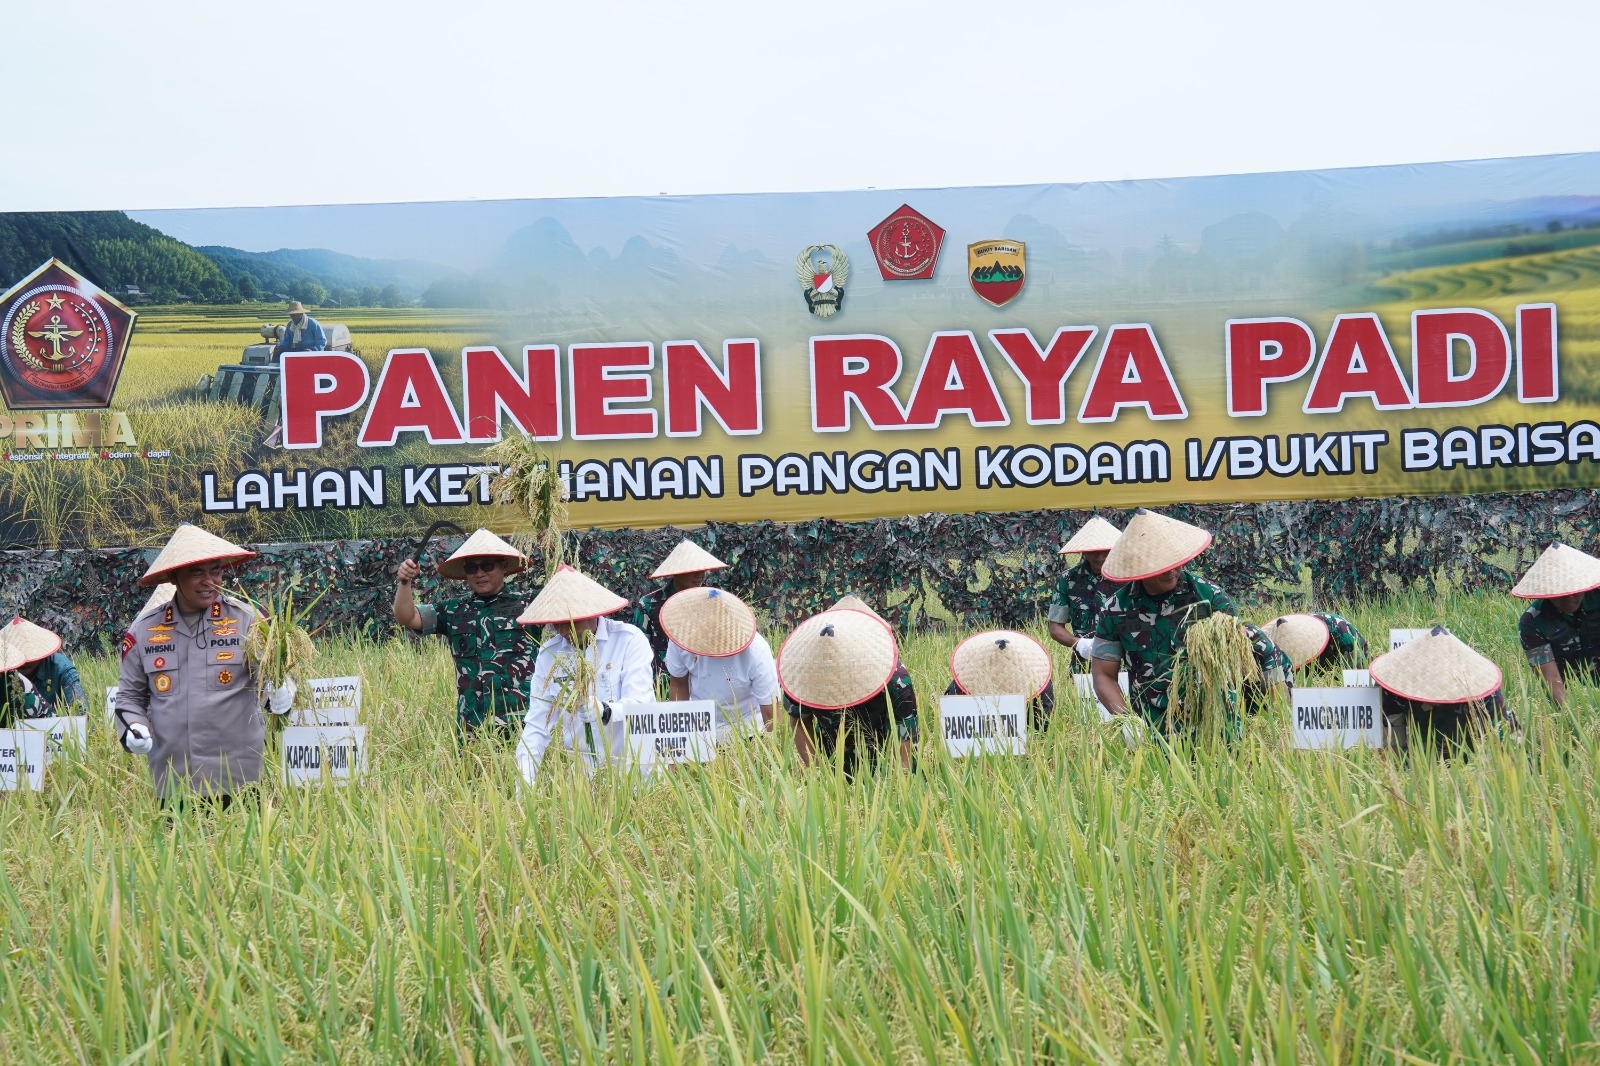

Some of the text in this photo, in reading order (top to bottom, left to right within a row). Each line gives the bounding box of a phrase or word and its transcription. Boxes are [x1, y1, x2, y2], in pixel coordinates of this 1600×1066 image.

[280, 303, 1559, 450] PANEN RAYA PADI
[203, 466, 385, 512] LAHAN
[738, 448, 960, 496] PANGAN
[977, 441, 1171, 489] KODAM
[1186, 431, 1388, 481] I/BUKIT
[145, 643, 176, 655] WHISNU
[210, 638, 240, 648] POLRI
[312, 685, 355, 693] ALIKOTA
[658, 711, 711, 734] GUBERNUR
[1297, 705, 1373, 730] PANGDAM I/BB
[287, 745, 322, 769] KAPOLD
